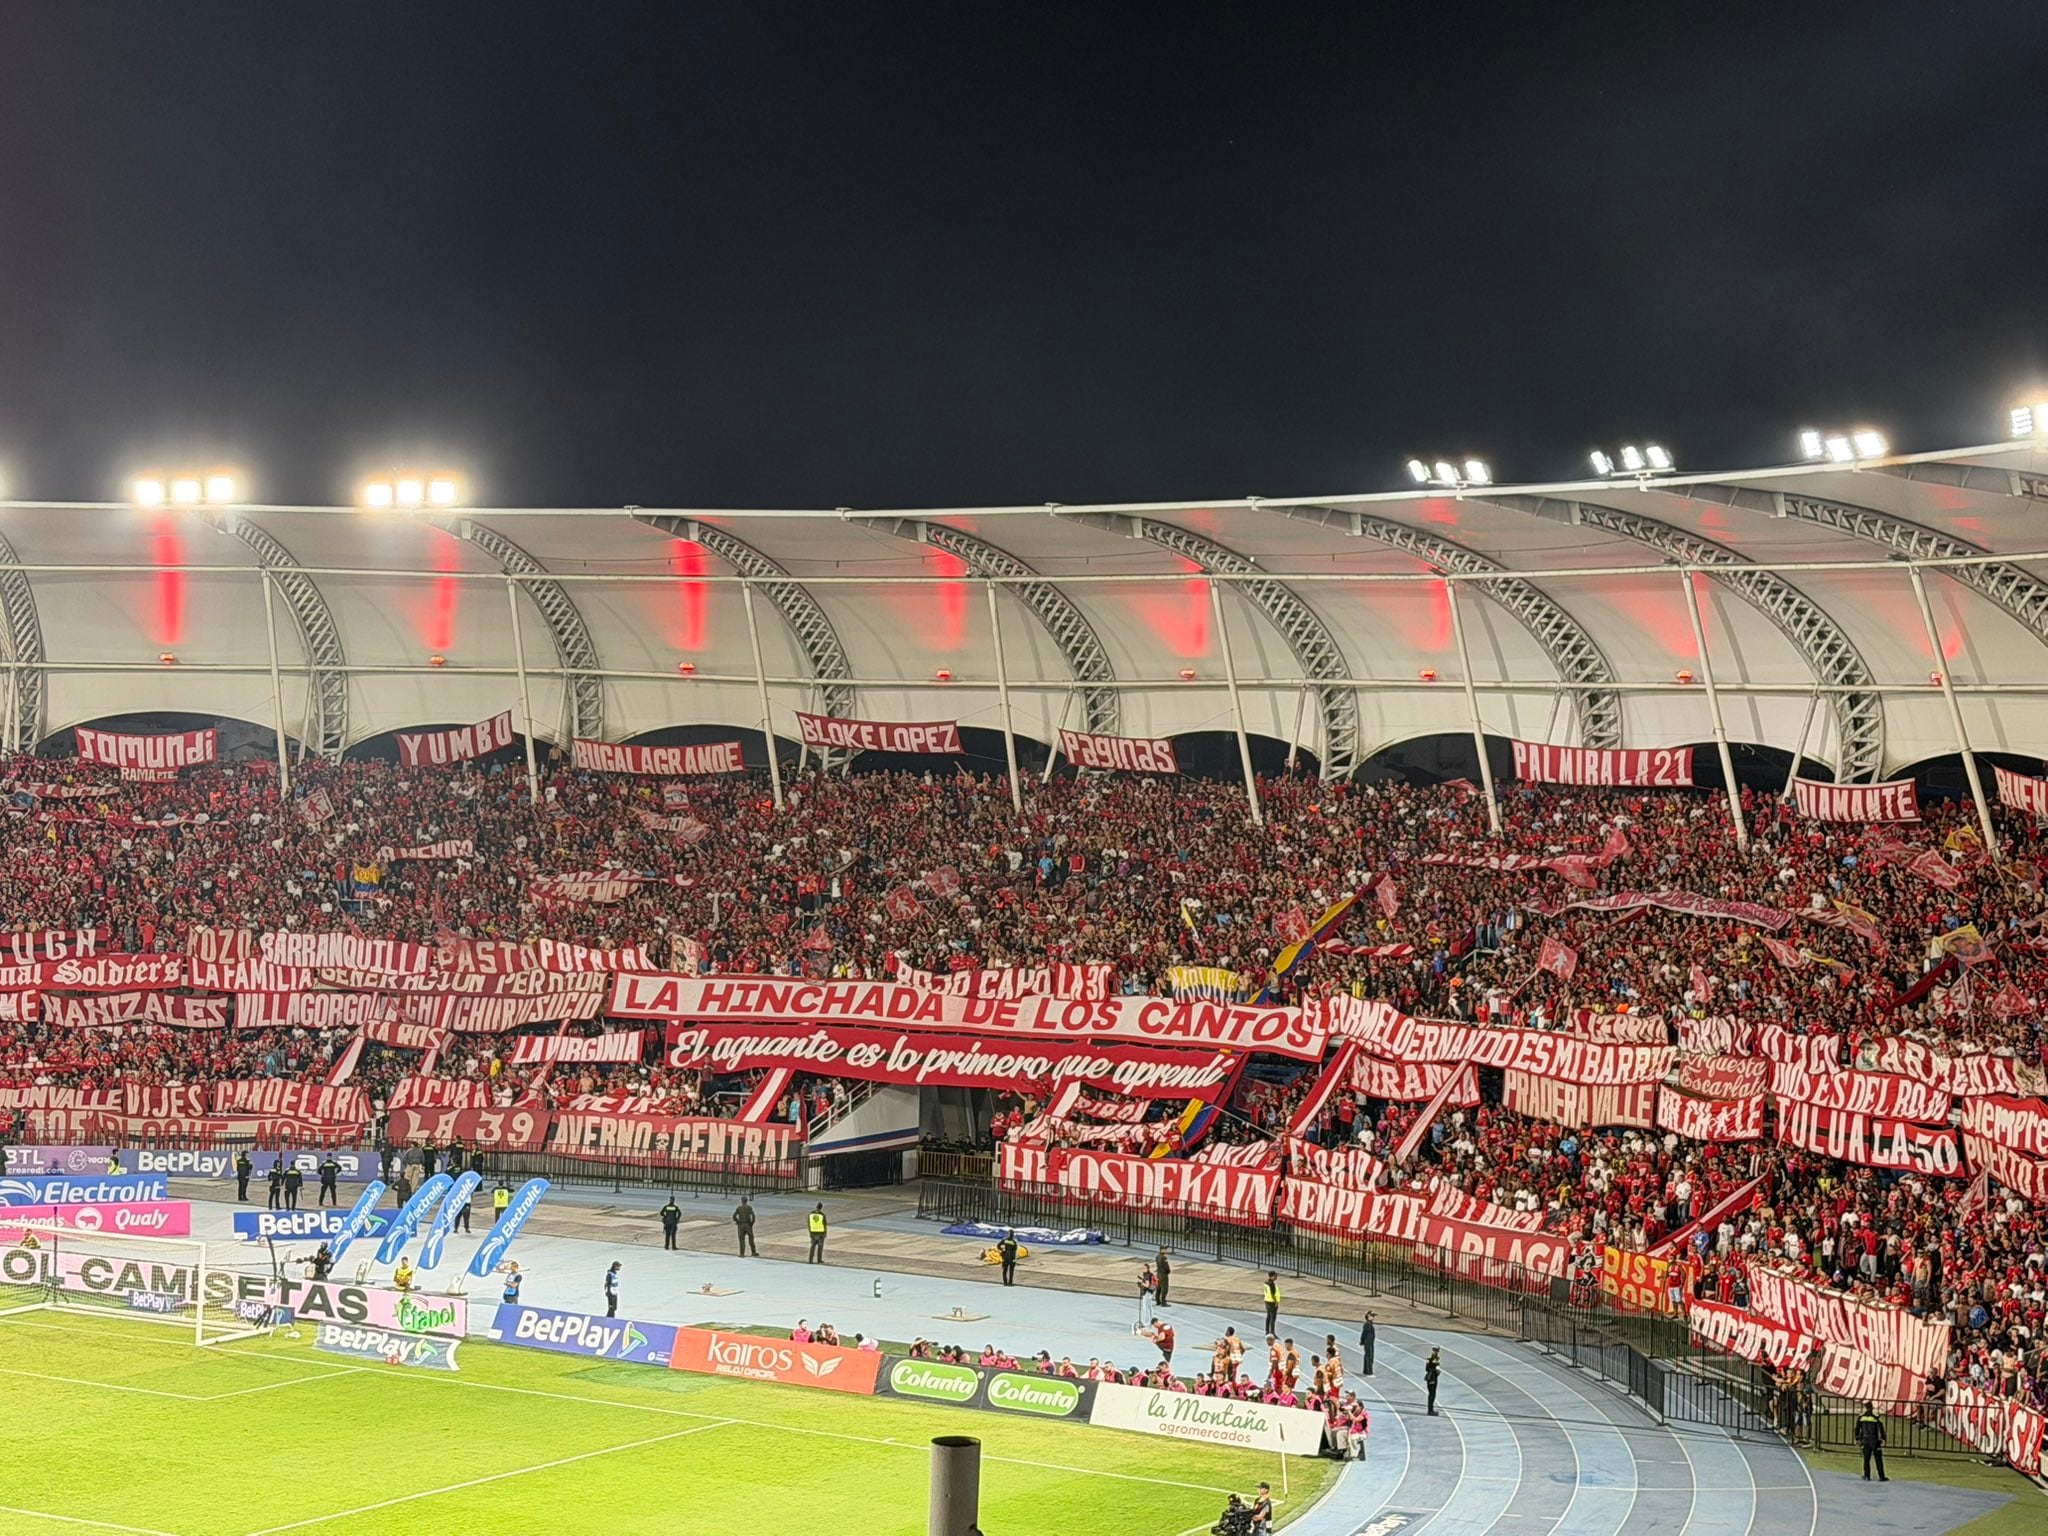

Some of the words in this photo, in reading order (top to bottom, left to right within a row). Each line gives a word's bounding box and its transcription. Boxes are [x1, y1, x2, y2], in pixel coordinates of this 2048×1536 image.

[401, 711, 513, 766] YUMBO
[800, 715, 874, 750] BLOKE
[879, 724, 963, 753] LOPEZ
[120, 767, 156, 782] RAMA
[1511, 740, 1614, 786] PALMIRA
[1618, 750, 1650, 786] LA
[1654, 749, 1692, 786] 21
[1794, 784, 1916, 822] DIAMANTE
[0, 929, 96, 965] UGA
[260, 932, 427, 975] BARRANQUILLA
[53, 954, 182, 987] Soldier's
[41, 993, 229, 1028] MANIZALES
[625, 979, 679, 1012] LA
[700, 983, 943, 1023] HINCHADA
[962, 997, 1022, 1028] DE
[1033, 996, 1122, 1031] LOS
[1138, 1001, 1313, 1049] CANTOS
[669, 1028, 709, 1068] El
[712, 1030, 847, 1071] aguante
[847, 1041, 889, 1067] es
[888, 1035, 921, 1072] lo
[1055, 1051, 1112, 1090] que
[49, 1086, 124, 1113] VALLE
[126, 1081, 204, 1119] VIJES
[1846, 1072, 1895, 1116] DEL
[404, 1109, 461, 1147] LA
[475, 1110, 534, 1148] 39
[552, 1114, 653, 1158] AVERNO
[671, 1122, 794, 1172] CENTRAL
[1776, 1097, 1868, 1165] TULUA
[138, 1153, 228, 1179] BetPlay
[43, 1180, 164, 1204] Electrolit
[502, 1184, 542, 1238] Electrolit
[1281, 1176, 1427, 1241] TEMPLETE
[115, 1208, 170, 1231] Qualy
[258, 1213, 348, 1237] BetPla
[1457, 1232, 1565, 1287] PLAGA
[81, 1257, 368, 1323] CAMISETAS
[133, 1290, 166, 1312] BetPlay
[323, 1325, 416, 1362] BetPlay
[516, 1309, 621, 1356] BetPlay
[707, 1333, 793, 1372] kairos
[893, 1365, 975, 1396] Colanta
[991, 1379, 1076, 1409] Colanta
[1159, 1421, 1252, 1443] agromercados
[1173, 1397, 1269, 1433] Montaña
